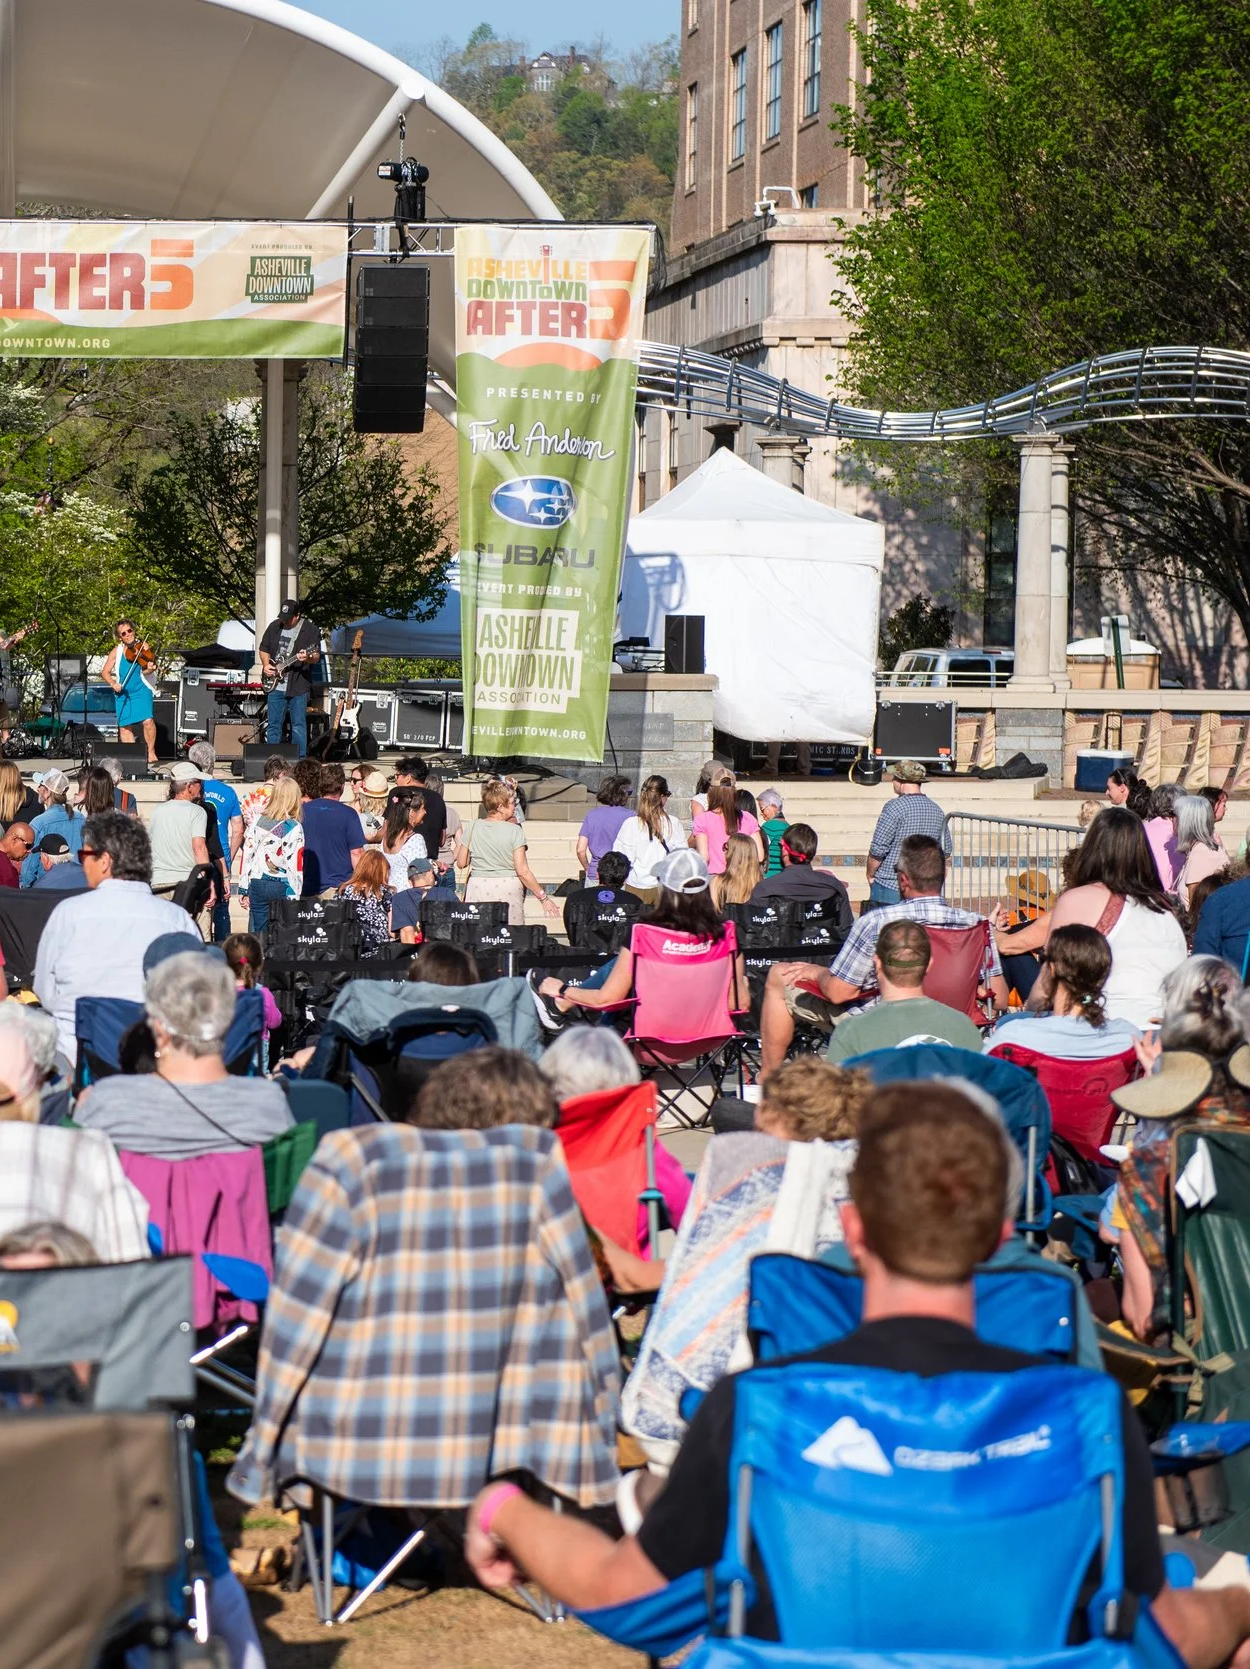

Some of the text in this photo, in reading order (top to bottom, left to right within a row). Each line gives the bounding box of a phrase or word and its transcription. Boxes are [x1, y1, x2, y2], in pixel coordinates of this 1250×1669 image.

[254, 259, 307, 276] ASHEVILLE
[467, 257, 586, 281] ASHEVILLE
[249, 277, 311, 294] DOWNTOWN
[466, 300, 587, 338] AFTER
[486, 387, 602, 404] PRESENTED BY
[469, 419, 520, 455] Fred
[478, 582, 513, 594] EVENT
[565, 586, 582, 597] BY
[826, 746, 856, 755] STNDS
[204, 791, 226, 803] WORLD
[298, 910, 320, 920] skyla
[451, 911, 474, 921] skyla
[598, 914, 620, 922] skyla
[752, 915, 771, 924] skyla
[298, 935, 321, 945] skyla
[481, 935, 505, 945] skyla
[746, 958, 772, 968] skyla
